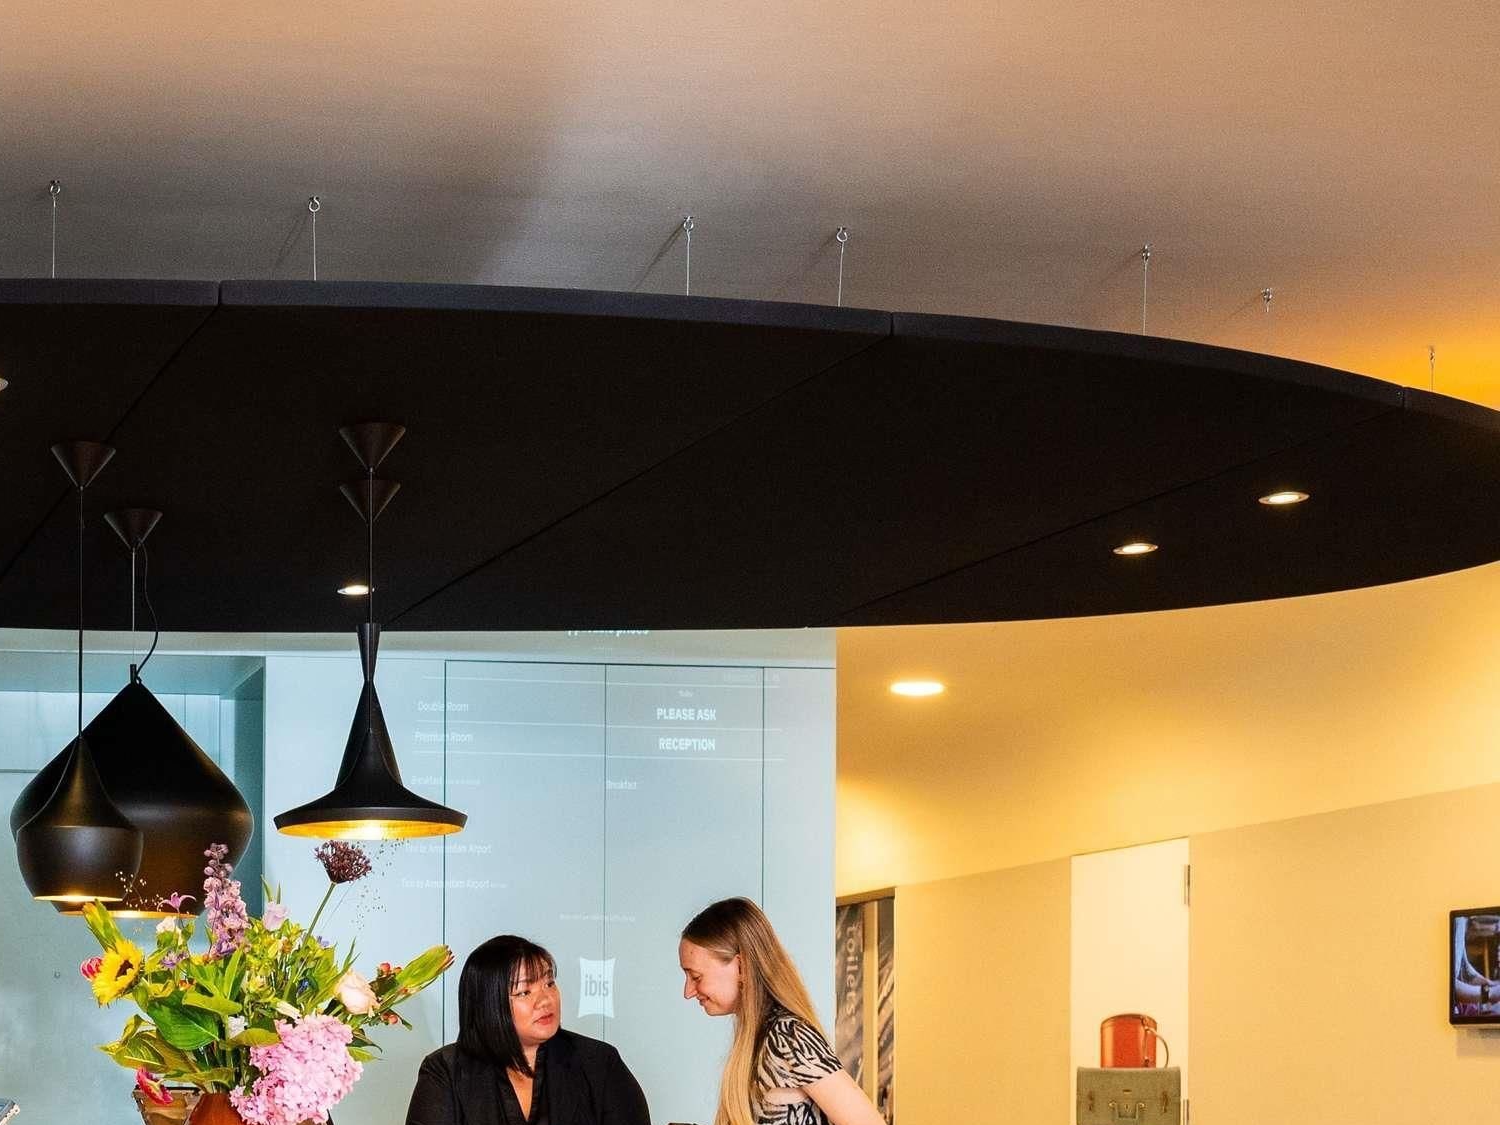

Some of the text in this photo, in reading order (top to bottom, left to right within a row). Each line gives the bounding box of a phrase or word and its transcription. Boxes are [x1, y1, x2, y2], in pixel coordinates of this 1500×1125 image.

[656, 707, 717, 721] PLEASE ASK
[658, 737, 716, 751] RECEPTION
[584, 973, 610, 998] ibis
